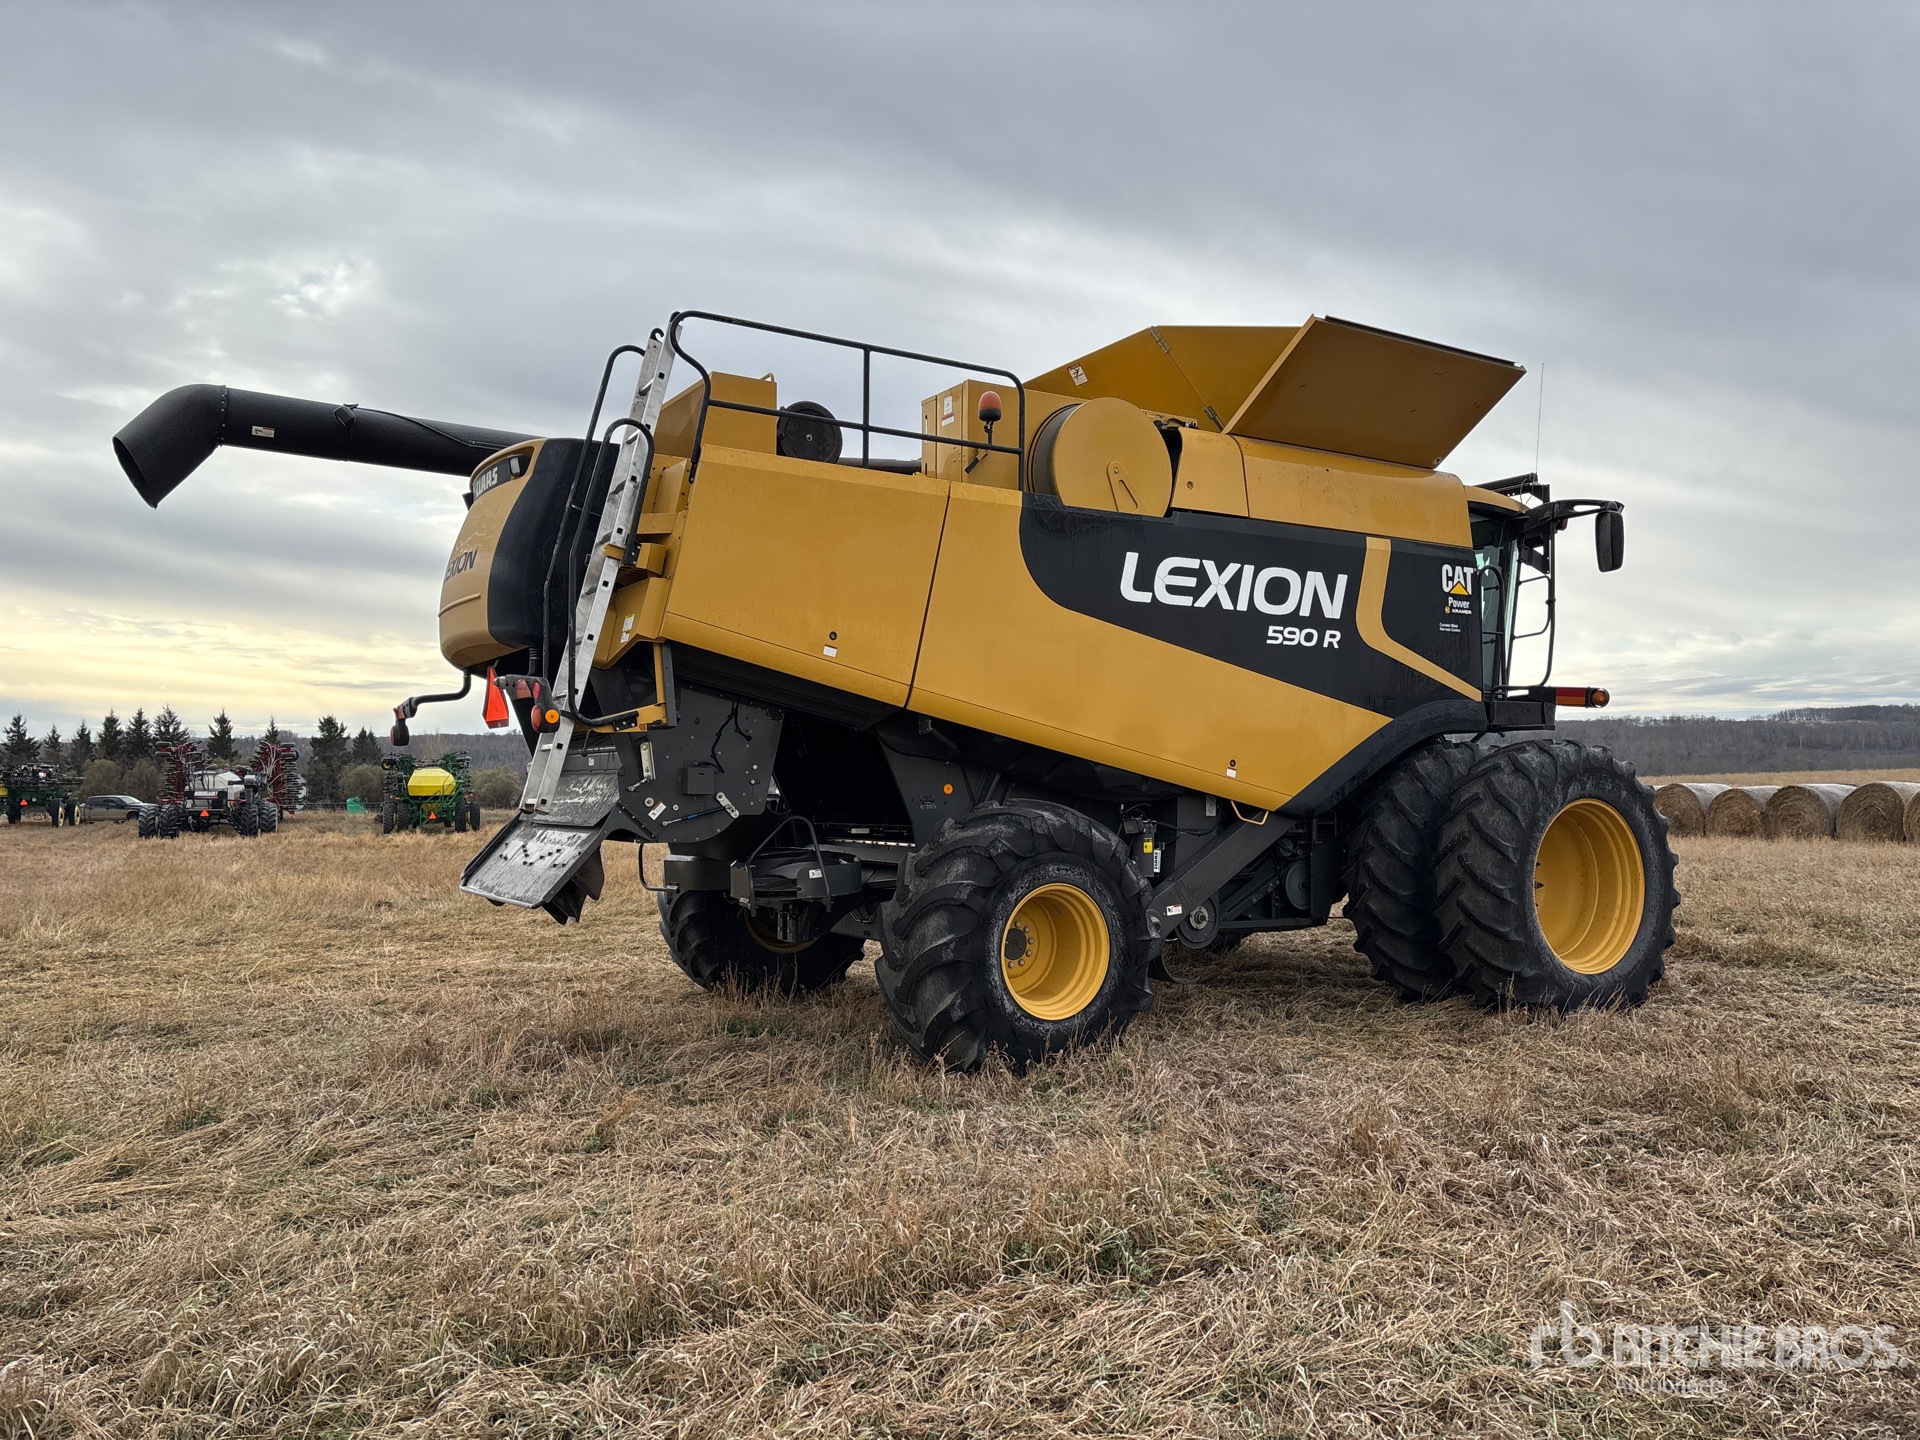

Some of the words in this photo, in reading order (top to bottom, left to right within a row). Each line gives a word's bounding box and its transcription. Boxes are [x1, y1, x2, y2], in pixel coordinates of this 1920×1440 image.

[1120, 551, 1348, 619] LEXION
[1441, 564, 1473, 595] CAT
[1448, 597, 1470, 608] Power
[1266, 625, 1318, 647] 590
[1323, 630, 1341, 648] R
